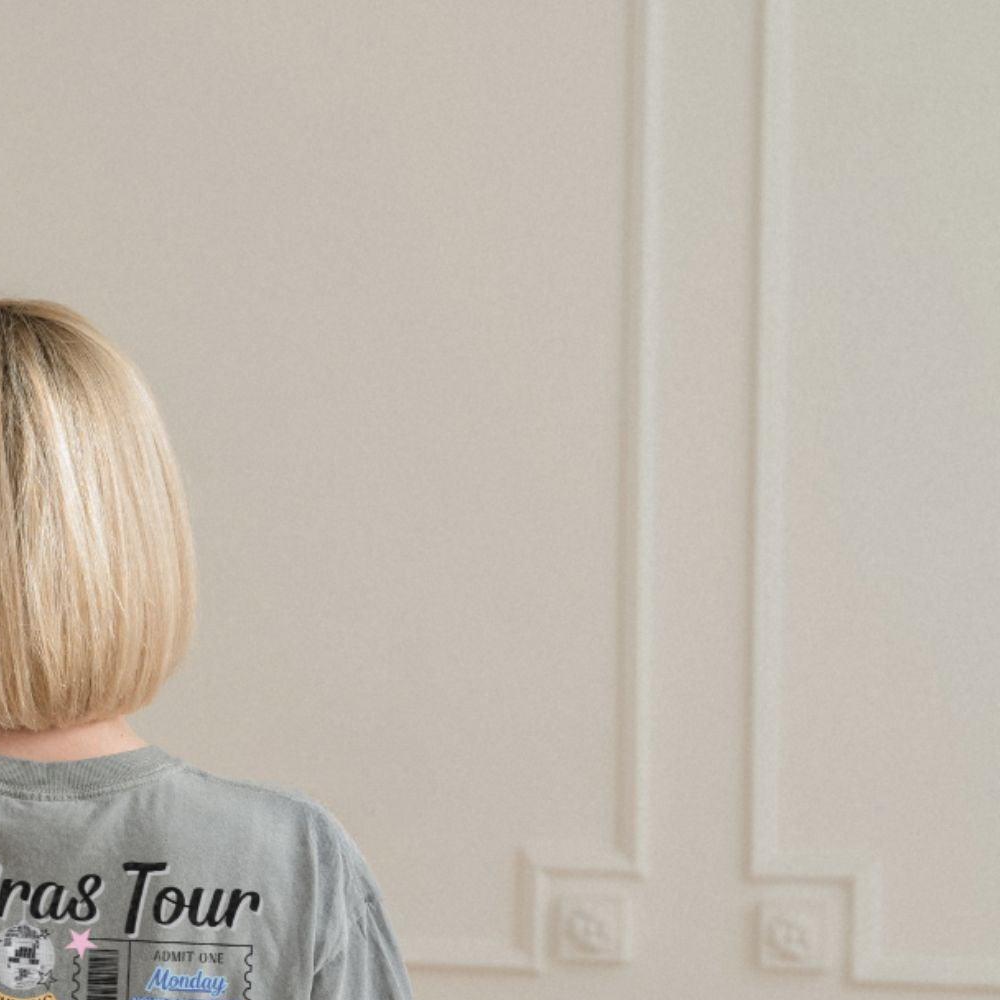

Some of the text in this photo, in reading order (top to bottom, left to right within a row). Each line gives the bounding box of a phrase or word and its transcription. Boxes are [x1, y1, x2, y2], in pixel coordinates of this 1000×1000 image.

[122, 862, 261, 937] Tour
[153, 950, 224, 964] ADMIT ONE
[146, 966, 227, 996] Monday
